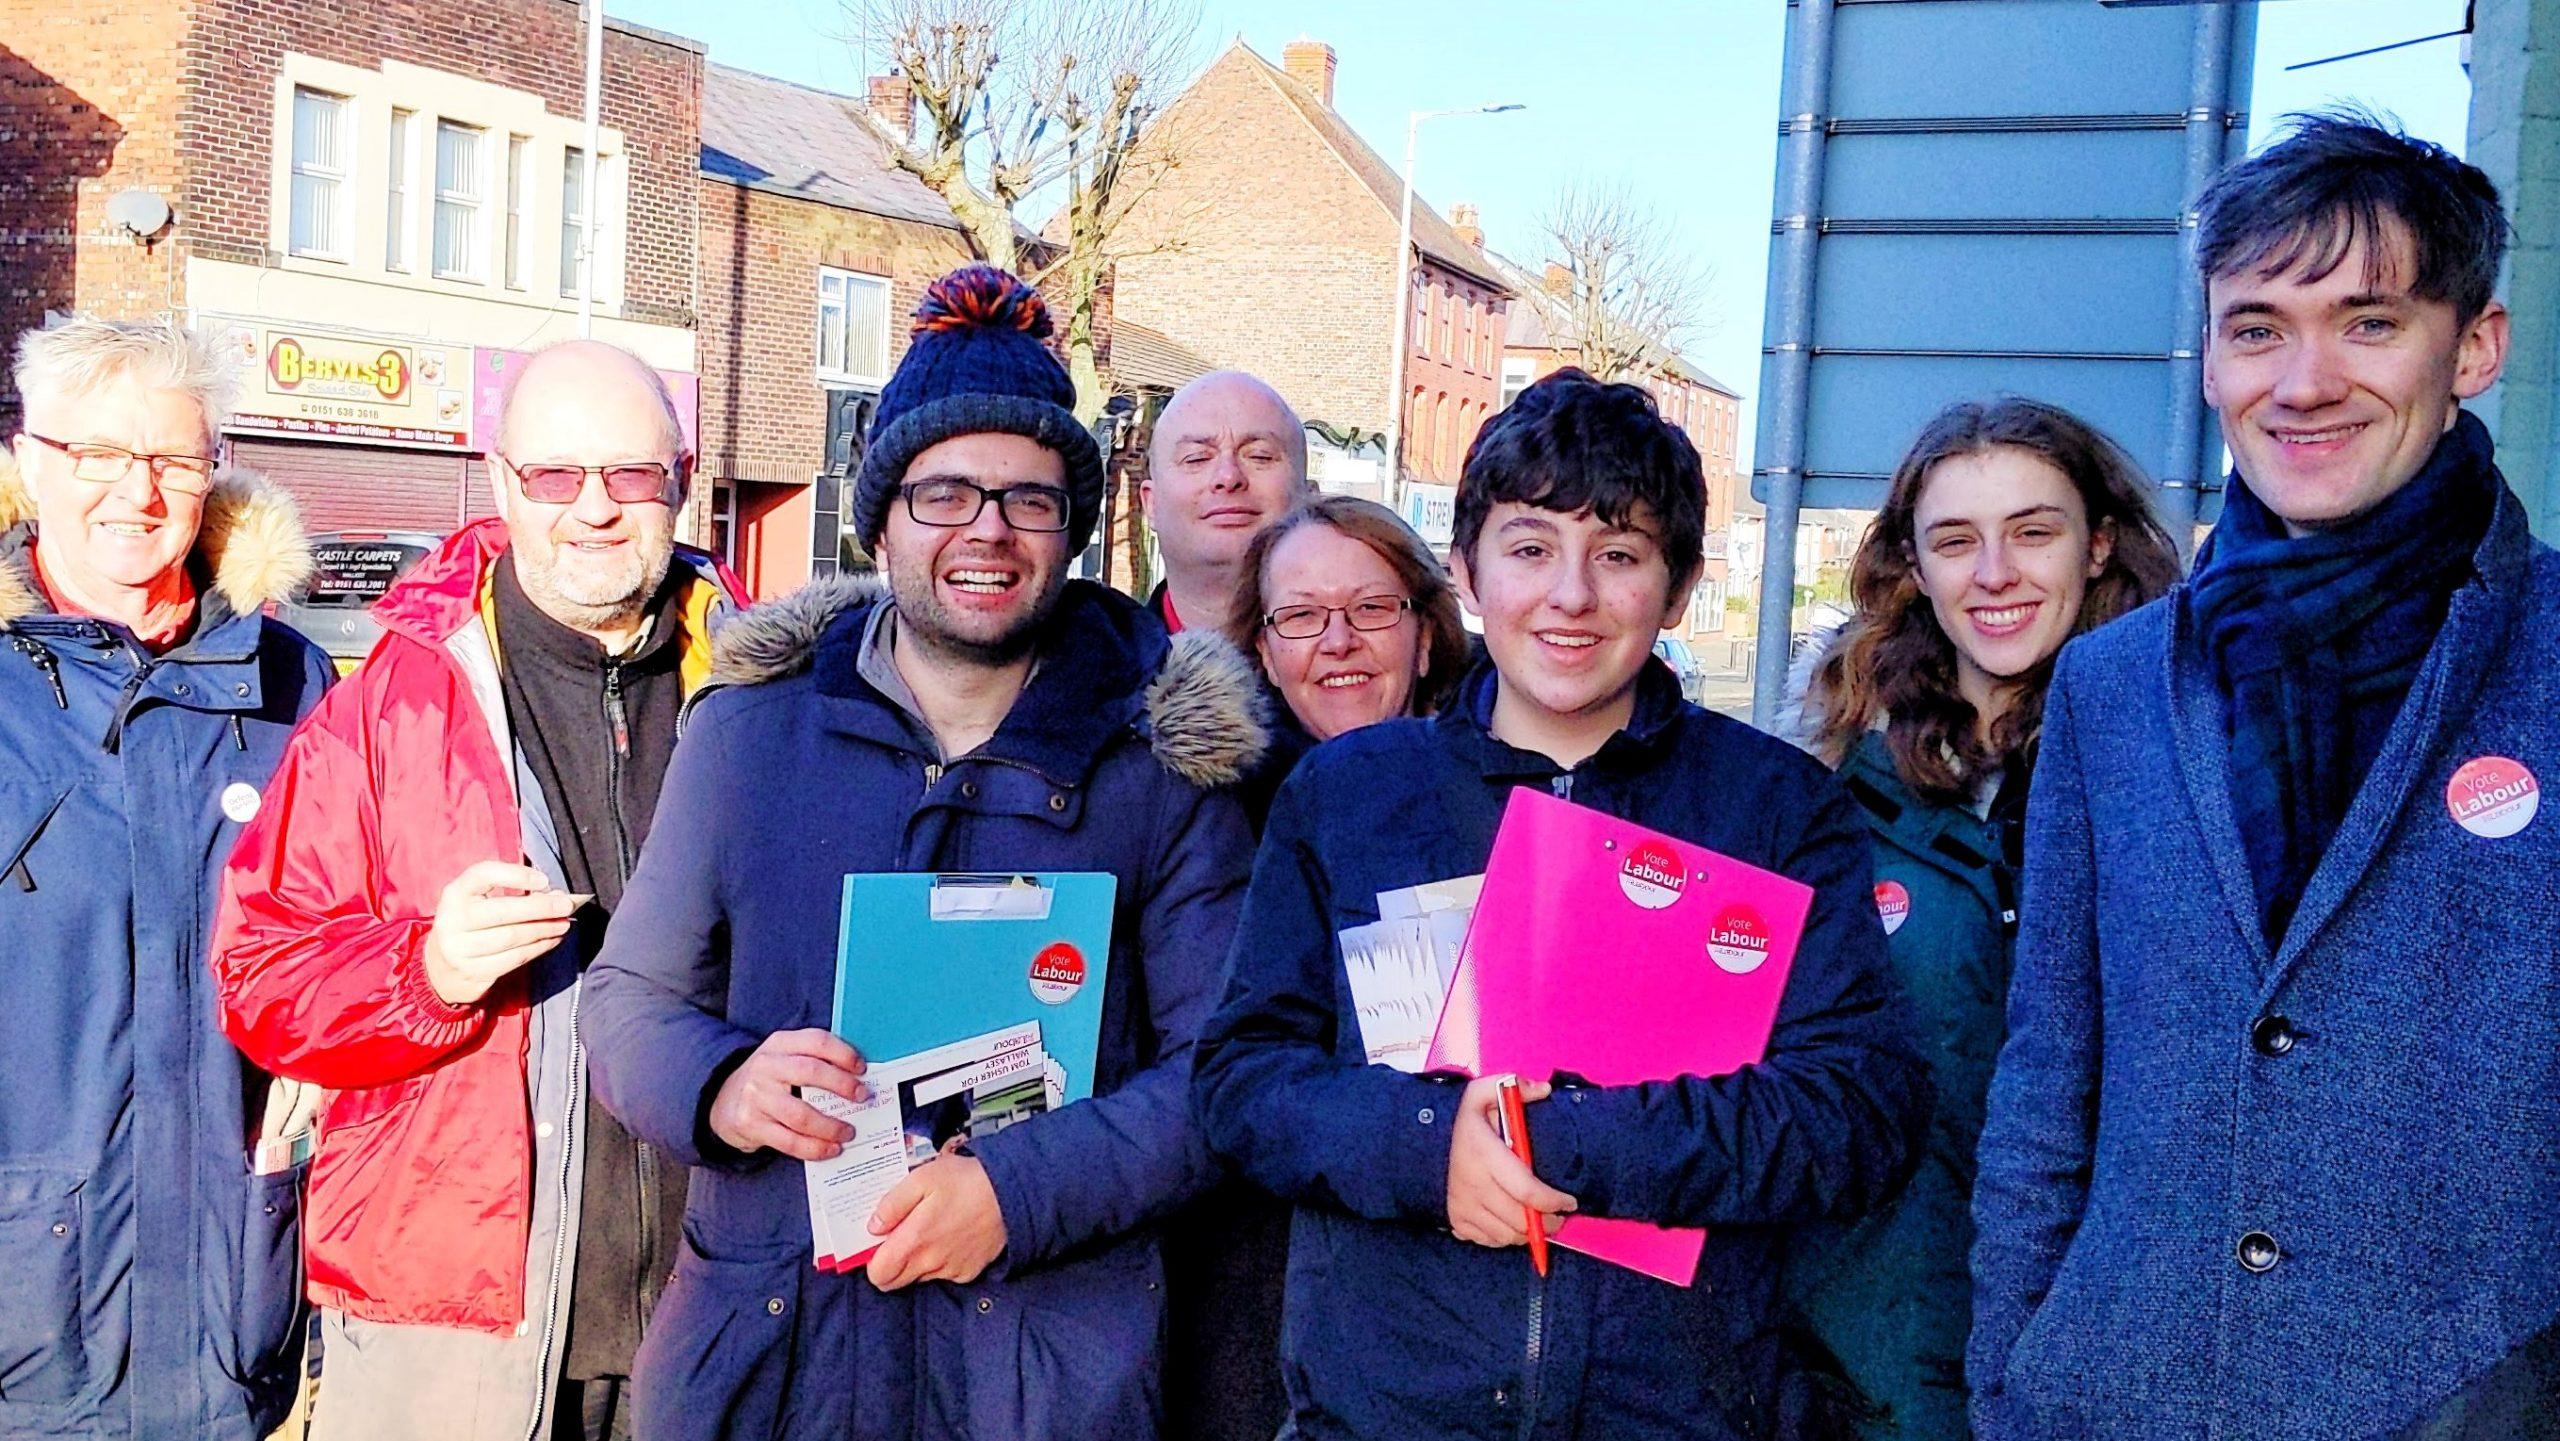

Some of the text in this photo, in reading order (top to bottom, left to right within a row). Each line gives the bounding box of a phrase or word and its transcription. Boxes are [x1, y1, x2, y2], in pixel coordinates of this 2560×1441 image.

[312, 406, 333, 416] 0151
[317, 551, 401, 562] CASTLE CARPETS
[2462, 771, 2500, 793] Vote
[2453, 775, 2530, 818] Labour
[1642, 850, 1670, 868] Vote
[1623, 858, 1684, 889] Labour
[1727, 916, 1752, 931] Vote
[1710, 927, 1769, 949] Labour
[1048, 953, 1071, 966] Vote
[1033, 963, 1083, 982] Labour
[985, 1049, 1030, 1069] WALLASEY
[1010, 1058, 1031, 1072] TOM
[980, 1064, 1009, 1081] USHER
[960, 1075, 979, 1088] FOR
